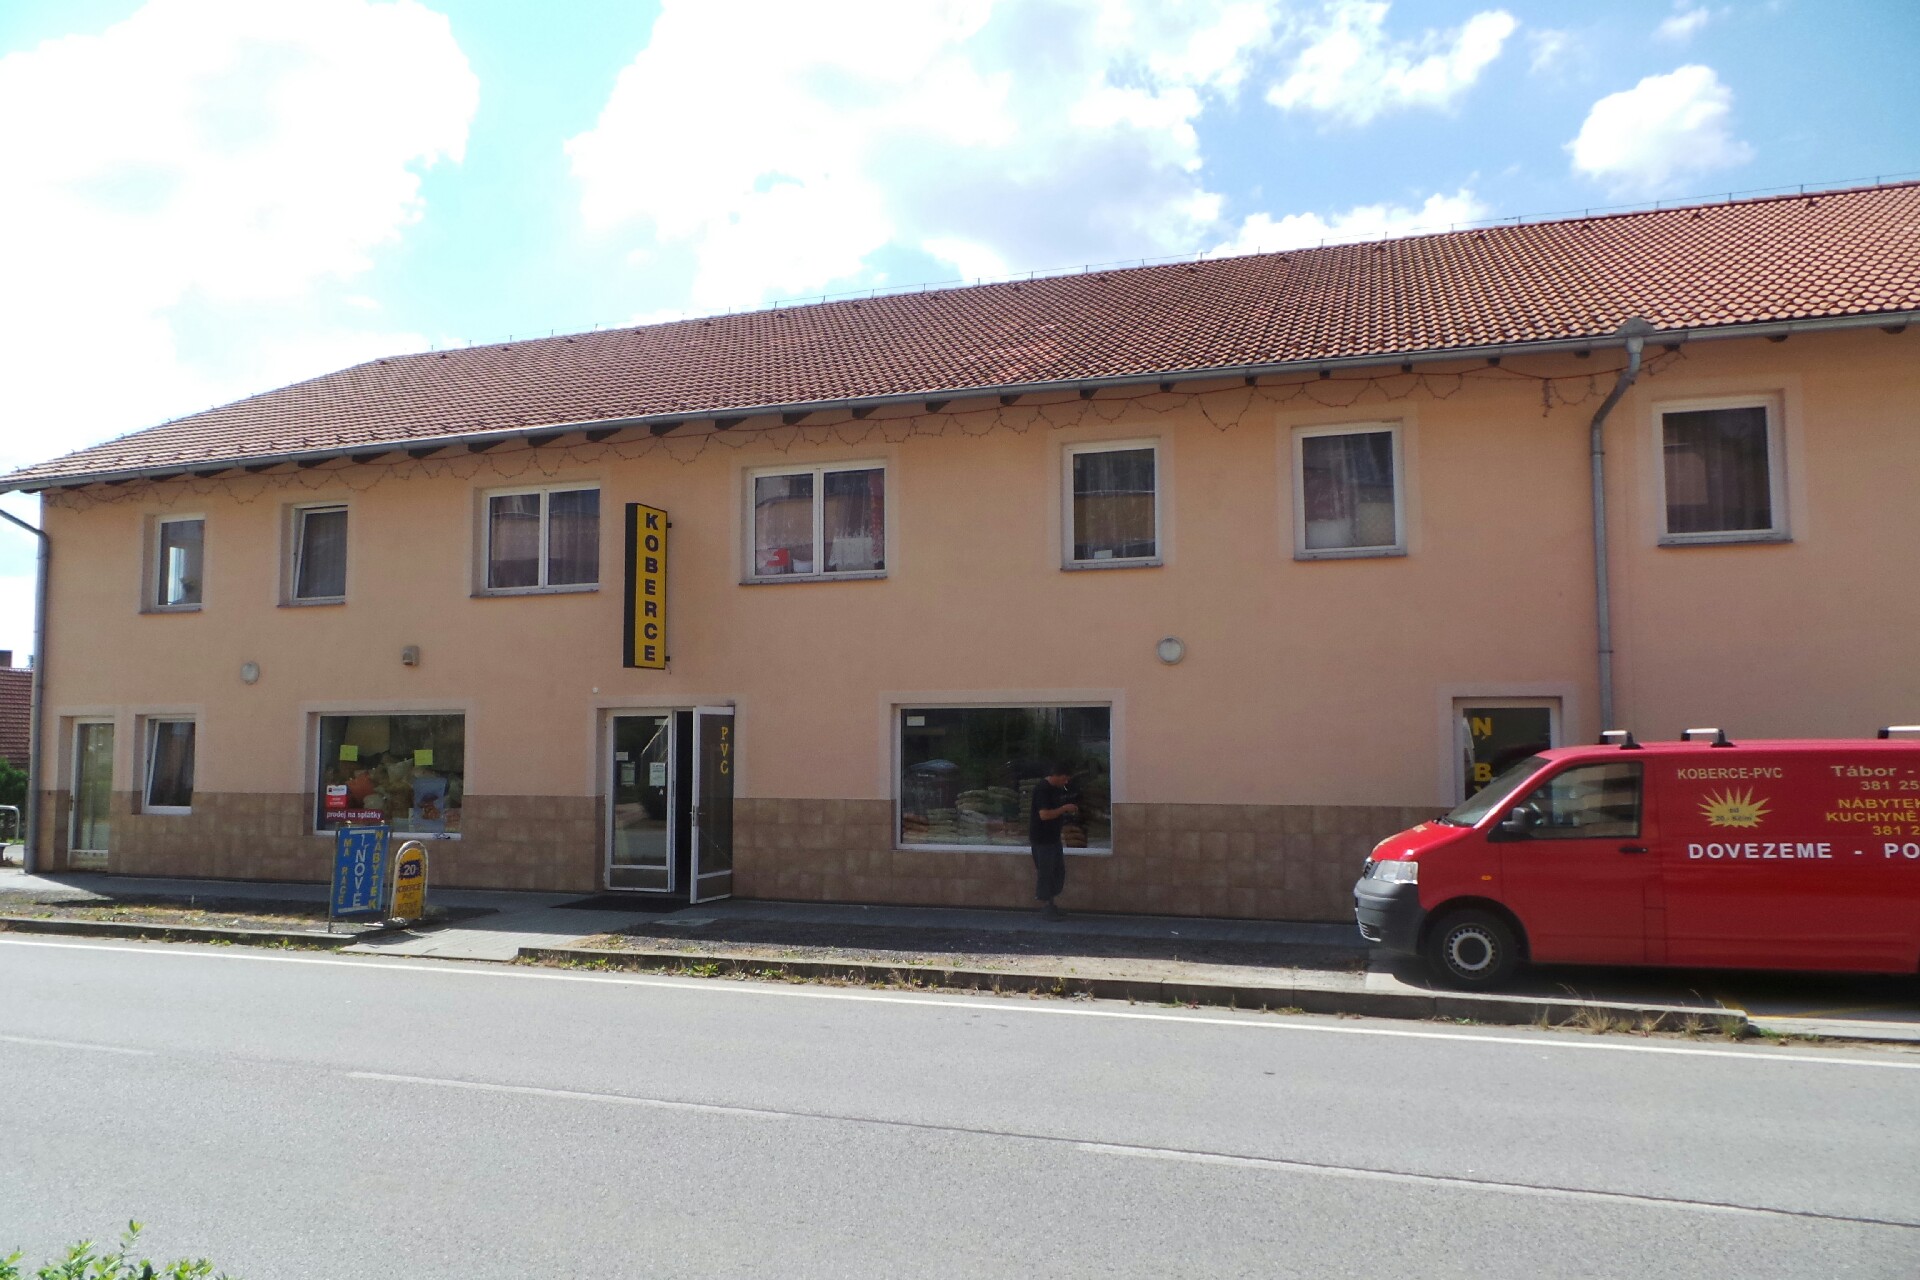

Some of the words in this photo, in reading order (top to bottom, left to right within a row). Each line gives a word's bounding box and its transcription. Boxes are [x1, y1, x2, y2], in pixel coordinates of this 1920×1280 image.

[644, 512, 659, 662] KOBERCE
[720, 726, 729, 774] PVC
[1677, 767, 1783, 780] KOBERCE-PVC
[1830, 765, 1897, 777] Tábor
[1860, 780, 1890, 791] 381
[326, 811, 347, 820] prodej
[357, 811, 382, 820] splátky
[1826, 810, 1918, 822] KUCHYNĚ
[1872, 825, 1901, 836] 381
[1688, 843, 1833, 859] DOVEZEME
[1884, 842, 1920, 859] PO
